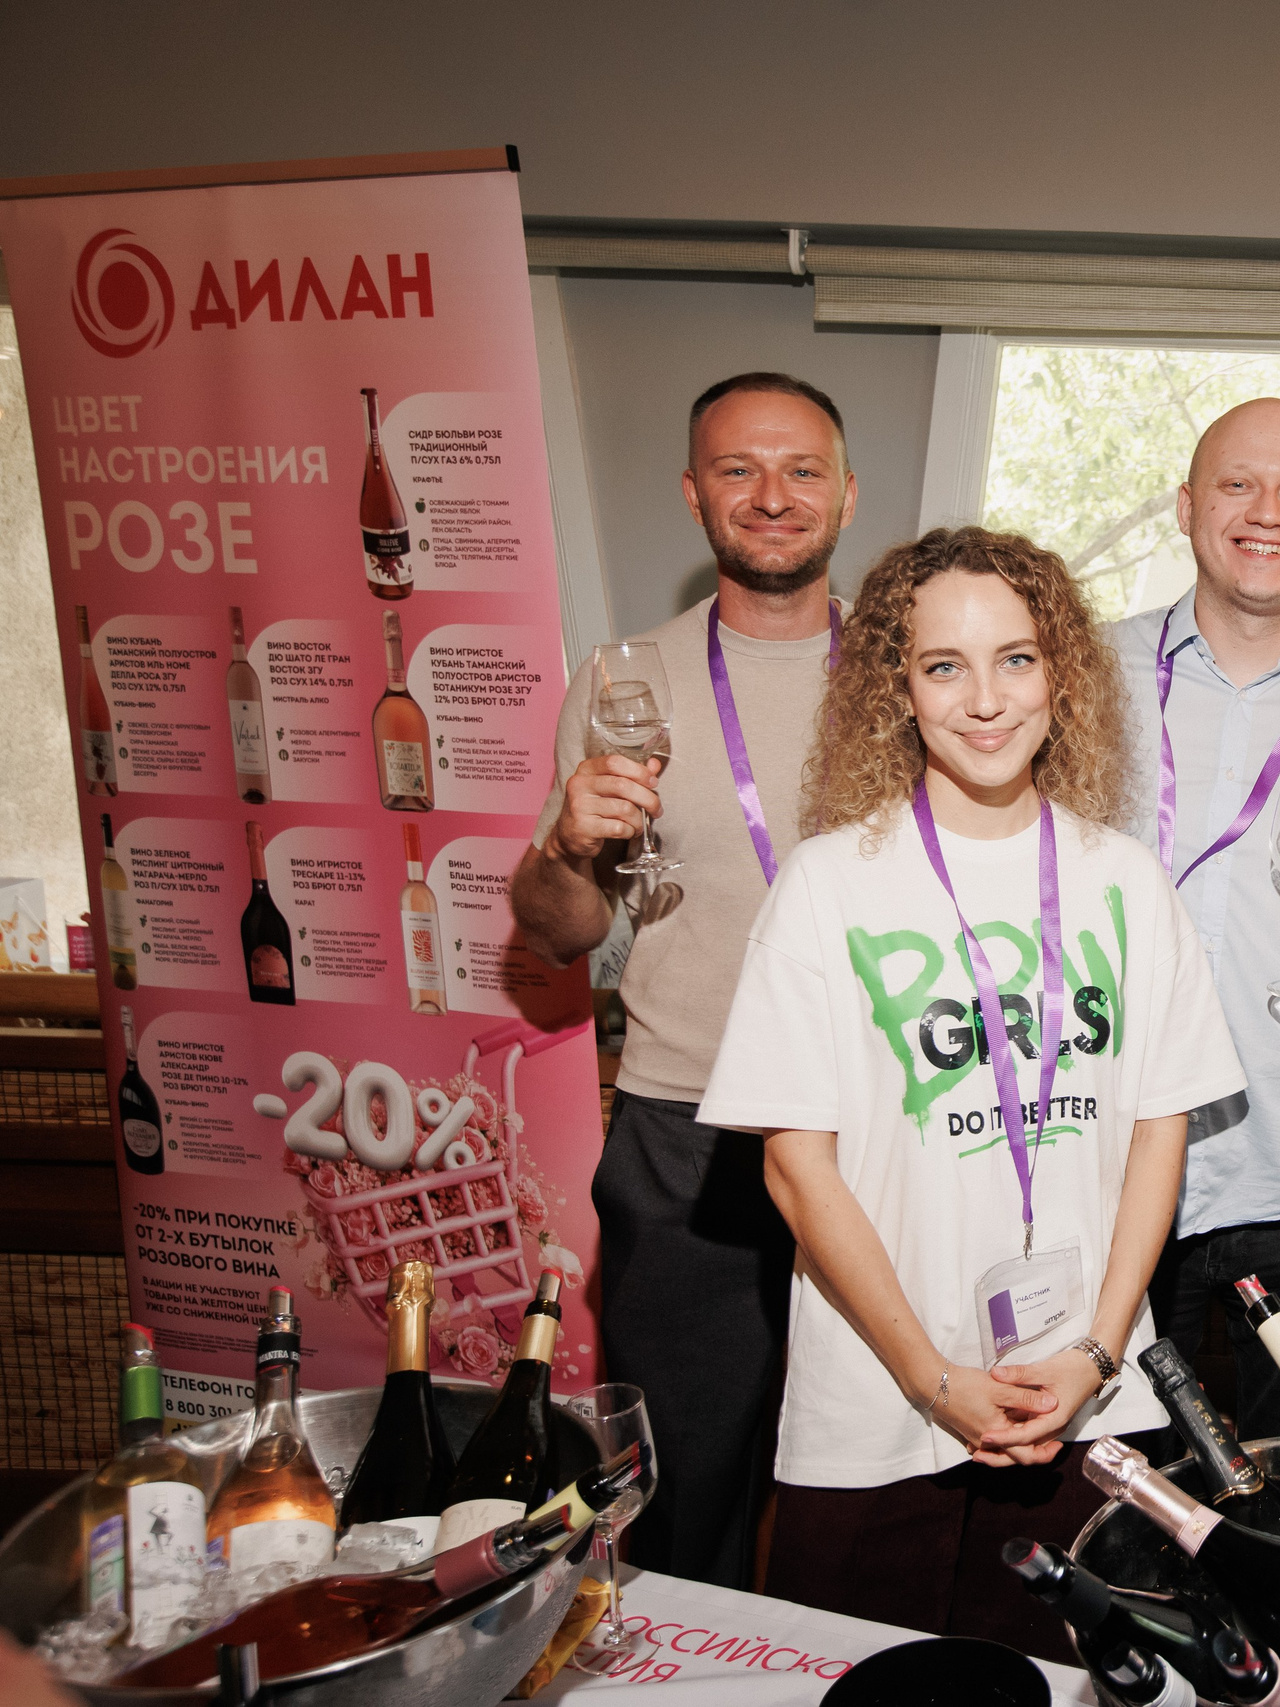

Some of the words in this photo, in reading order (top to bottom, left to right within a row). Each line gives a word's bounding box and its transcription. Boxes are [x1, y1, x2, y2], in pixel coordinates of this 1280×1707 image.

[190, 252, 434, 330] ДИЛАН
[52, 395, 142, 435] ЦВЕТ
[409, 430, 433, 439] СИДР
[435, 430, 476, 438] БЮЛЬВИ
[478, 430, 502, 438] РОЗЕ
[409, 441, 488, 452] ТРАДИЦИОННЫЙ
[58, 446, 328, 484] НАСТРОЕНИЯ
[411, 456, 439, 464] П/СУХ
[441, 456, 458, 464] ГАЗ
[460, 456, 473, 464] 6%
[475, 456, 501, 465] 0,75Л
[64, 501, 259, 574] РОЗЕ
[107, 636, 128, 645] ВИНО
[130, 637, 162, 646] КУБАНЬ
[267, 642, 292, 650] ВИНО
[294, 642, 331, 651] ВОСТОК
[108, 648, 156, 656] ТАМАНСКИЙ
[158, 650, 216, 659] ПОЛУОСТРОВ
[429, 647, 454, 655] ВИНО
[456, 648, 503, 657] ИГРИСТОЕ
[269, 654, 283, 662] ДЮ
[285, 654, 312, 662] ШАТО
[328, 655, 350, 663] ГРАН
[110, 659, 145, 668] АРИСТОВ
[147, 660, 164, 669] ИЛЬ
[167, 661, 191, 670] НОМЕ
[270, 665, 305, 674] ВОСТОК
[308, 666, 323, 674] ЗГУ
[431, 659, 465, 668] КУБАНЬ
[466, 660, 526, 670] ТАМАНСКИЙ
[111, 671, 136, 679] ДЕЛЛА
[138, 672, 161, 680] РОСА
[163, 672, 177, 680] ЗГУ
[432, 671, 493, 681] ПОЛУОСТРОВ
[495, 674, 541, 682] АРИСТОВ
[112, 682, 126, 690] РОЗ
[128, 683, 144, 691] СУХ
[145, 684, 161, 692] 12%
[163, 684, 186, 693] 0,75Л
[271, 677, 287, 685] РОЗ
[289, 678, 307, 686] СУХ
[310, 678, 327, 686] 14%
[329, 679, 353, 687] 0,75Л
[433, 683, 486, 693] БОТАНИКУМ
[489, 685, 513, 693] РОЗЕ
[515, 686, 532, 695] ЗГУ
[434, 695, 450, 704] 12%
[452, 696, 469, 704] РОЗ
[471, 697, 497, 705] БРЮТ
[499, 698, 526, 707] 0,75Л
[436, 715, 483, 723] КУБАНЬ-ВИНО
[130, 848, 152, 856] ВИНО
[154, 850, 191, 858] ЗЕЛЕНОЕ
[131, 859, 169, 867] РИСЛИНГ
[170, 861, 225, 871] ЦИТРОННЫЙ
[291, 859, 314, 867] ВИНО
[317, 860, 363, 869] ИГРИСТОЕ
[449, 860, 471, 869] ВИНО
[133, 870, 208, 881] МАГАРАЧА-МЕРЛО
[292, 870, 335, 879] ТРЕСКАРЕ
[337, 872, 365, 881] 11-13%
[450, 872, 474, 880] БЛАШ
[476, 874, 508, 883] МИРАЖ
[151, 881, 177, 890] П/СУХ
[179, 883, 196, 892] 10%
[198, 885, 220, 893] 0,75Л
[293, 881, 310, 889] РОЗ
[312, 882, 336, 890] БРЮТ
[339, 884, 363, 892] 0,75Л
[451, 883, 467, 891] РОЗ
[468, 885, 485, 893] СУХ
[452, 901, 492, 911] РУСВИНТОРГ
[158, 1040, 181, 1048] ВИНО
[183, 1042, 225, 1052] ИГРИСТОЕ
[159, 1051, 197, 1060] АРИСТОВ
[199, 1053, 223, 1062] КЮВЕ
[160, 1062, 210, 1072] АЛЕКСАНДР
[162, 1072, 182, 1080] РОЗЕ
[196, 1074, 219, 1083] ПИНО
[221, 1077, 248, 1086] 10-12%
[163, 1082, 179, 1090] РОЗ
[181, 1083, 203, 1092] БРЮТ
[205, 1085, 227, 1094] 0,75Л
[165, 1099, 209, 1108] КУБАНЬ-ВИНО
[252, 1050, 476, 1171] -20%
[948, 1111, 984, 1137] DO
[133, 1202, 171, 1222] -20%
[175, 1209, 211, 1225] ПРИ
[215, 1213, 297, 1236] ПОКУПКЕ
[136, 1224, 154, 1239] ОТ
[158, 1229, 185, 1245] 2-Х
[189, 1232, 275, 1256] БУТЫЛОК
[138, 1246, 227, 1272] РОЗОВОГО
[232, 1259, 281, 1278] ВИНА
[142, 1276, 148, 1285] В
[150, 1279, 183, 1292] АКЦИИ
[185, 1283, 198, 1292] НЕ
[200, 1285, 260, 1300] УЧАСТВУЮТ
[144, 1288, 182, 1303] ТОВАРЫ
[184, 1296, 198, 1305] НА
[201, 1298, 245, 1311] ЖЕЛТОМ
[246, 1303, 269, 1314] ЦЕН
[1014, 1286, 1052, 1305] УЧАСТНИК
[145, 1302, 164, 1313] УЖЕ
[166, 1306, 181, 1316] СО
[183, 1307, 251, 1324] СНИЖЕННОЙ
[161, 1374, 233, 1396] ТЕЛЕФОН
[236, 1384, 256, 1400] ГО
[166, 1399, 173, 1410] 8
[177, 1401, 205, 1416] 800
[208, 1405, 233, 1418] 301
[601, 1615, 854, 1680] ОССИЙСКО
